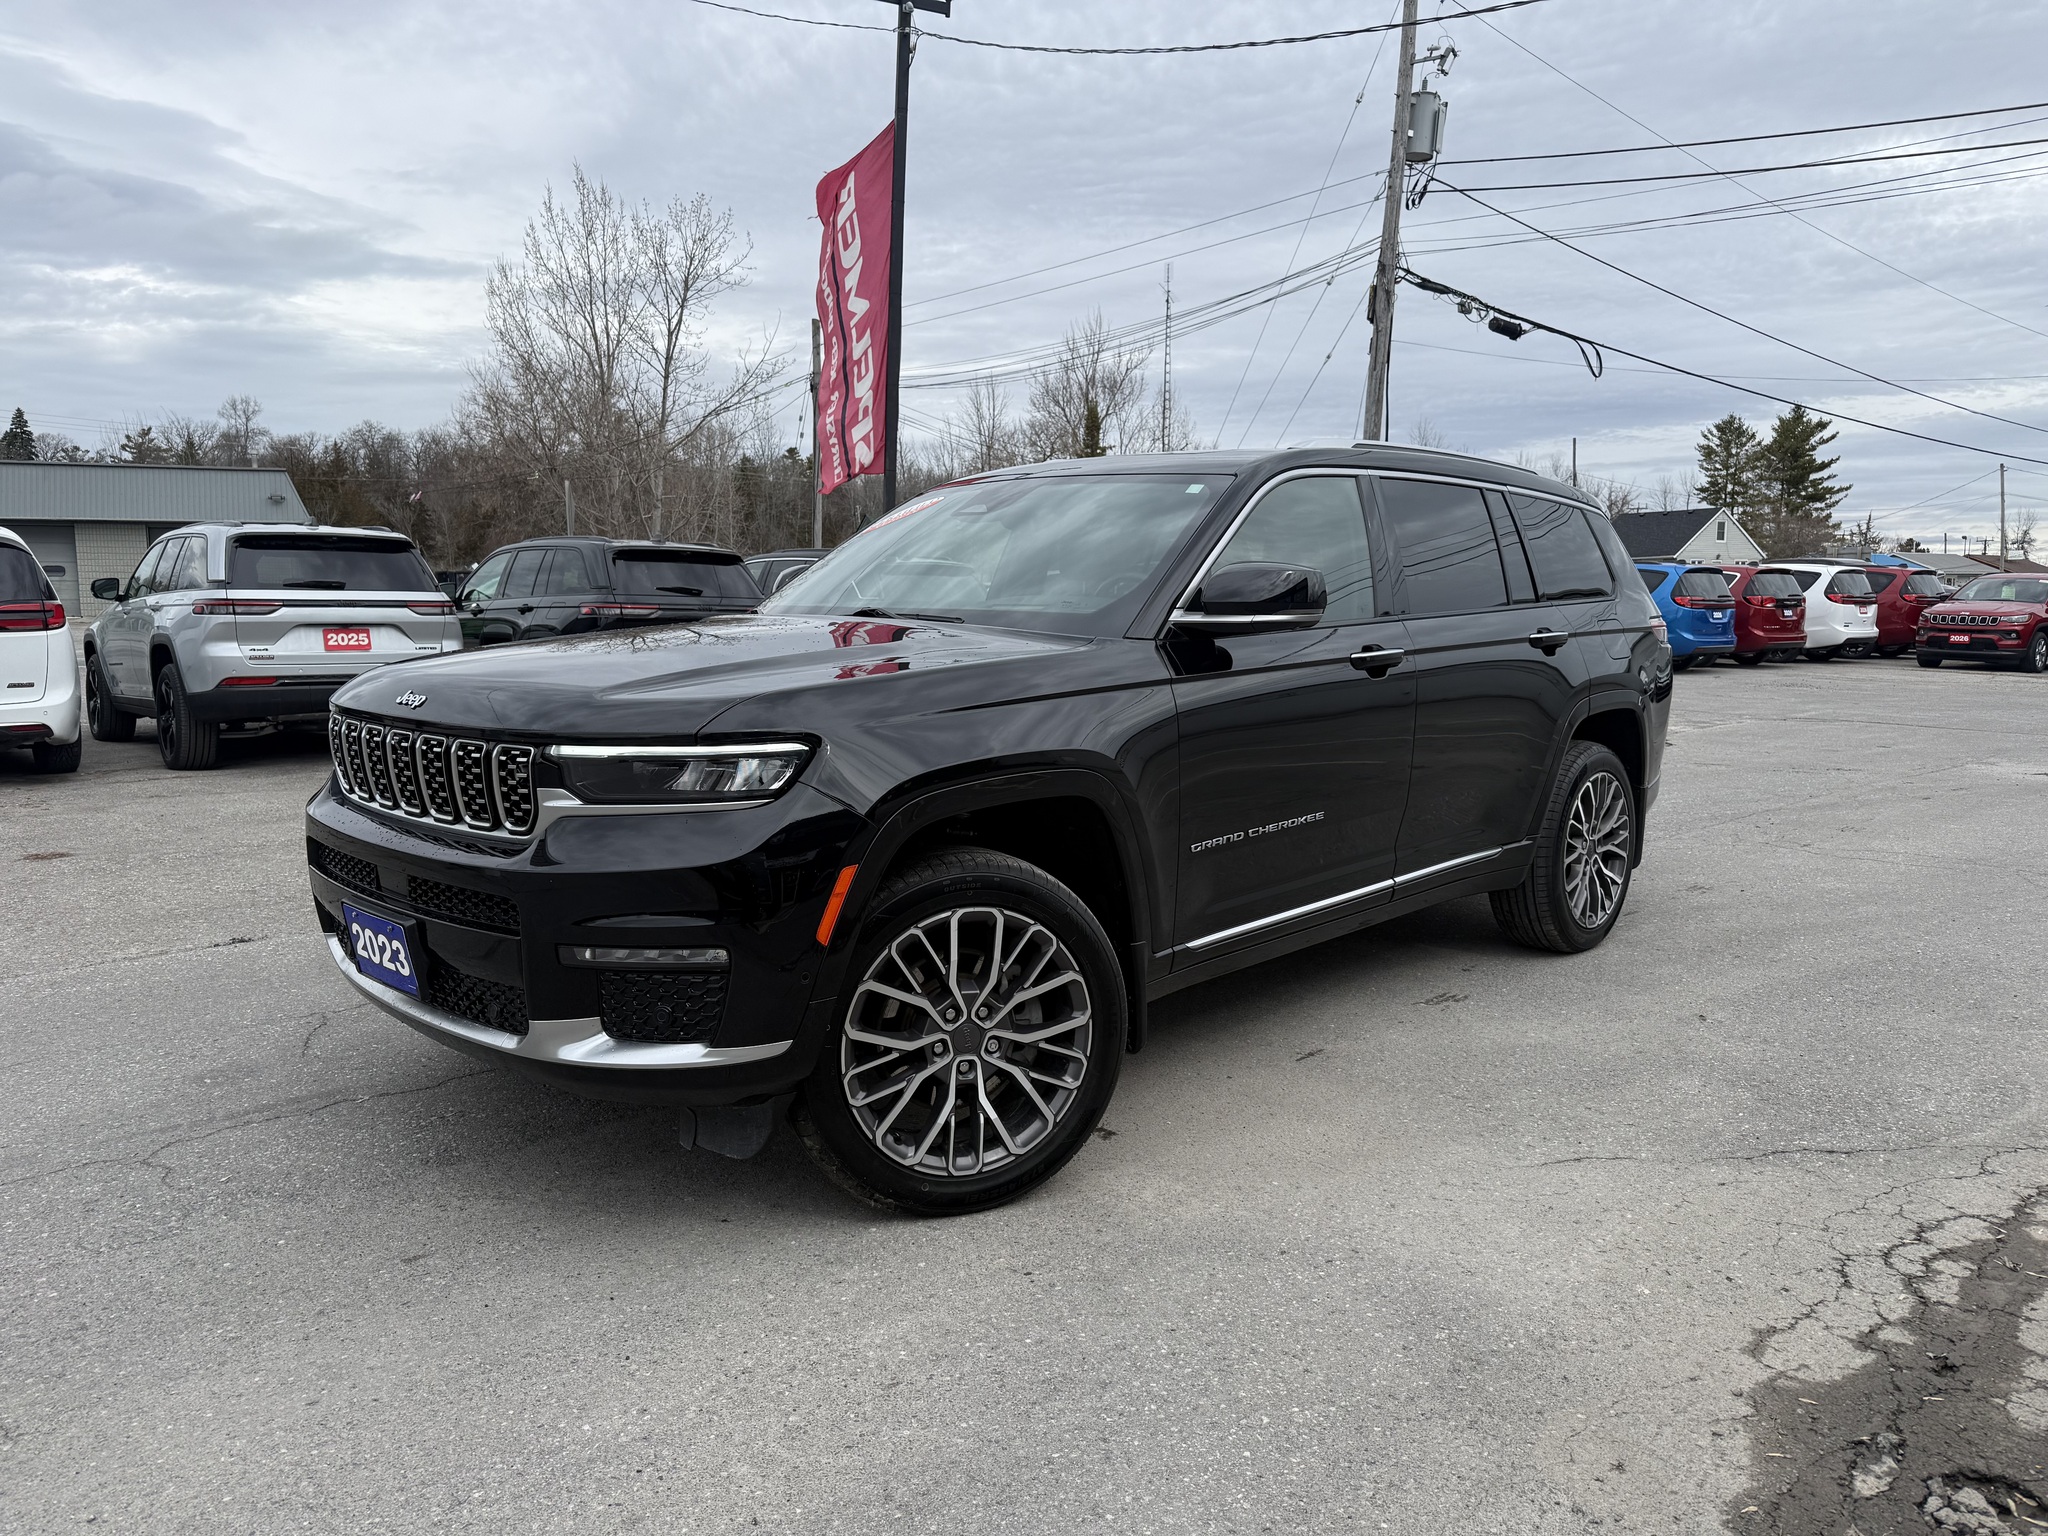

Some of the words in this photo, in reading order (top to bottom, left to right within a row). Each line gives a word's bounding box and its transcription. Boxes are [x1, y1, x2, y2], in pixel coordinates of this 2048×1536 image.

[326, 632, 369, 646] 2025
[1949, 634, 1970, 642] 2026
[395, 689, 428, 710] Jeep
[1190, 831, 1245, 853] GRAND
[1247, 811, 1325, 838] CHEROKEE
[943, 882, 982, 893] OUTSIDE
[351, 922, 411, 977] 2023
[963, 1026, 972, 1049] Jeep
